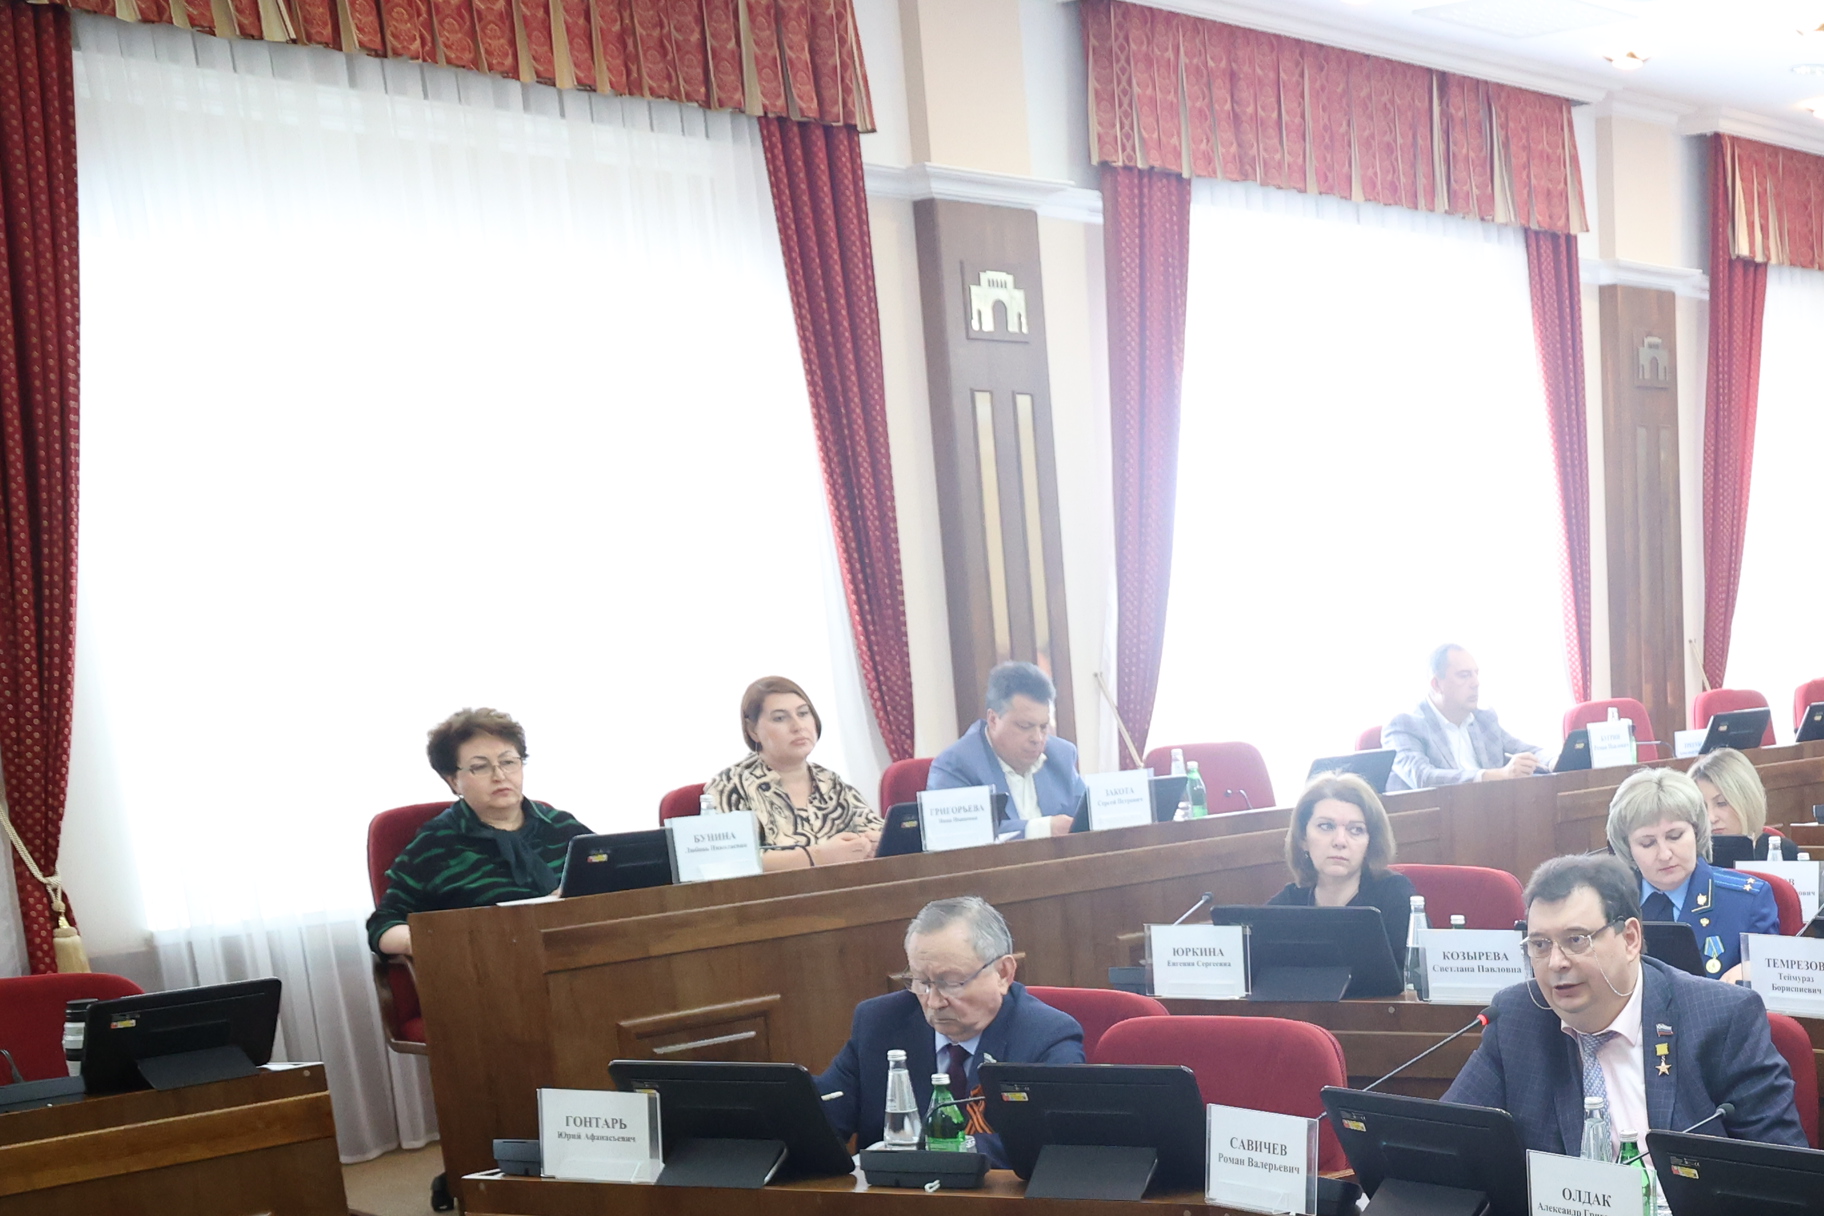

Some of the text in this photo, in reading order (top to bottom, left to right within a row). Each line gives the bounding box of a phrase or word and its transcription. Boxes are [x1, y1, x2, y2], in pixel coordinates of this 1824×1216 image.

[929, 804, 985, 816] ГРИГОРЬЕВА
[693, 832, 737, 843] БУНИНА
[1172, 947, 1225, 957] ЮРКИНА
[1442, 951, 1509, 961] КОЗЫРЕВА
[1432, 964, 1522, 974] Светлана Павловна
[1778, 972, 1815, 984] Теймураз
[565, 1115, 627, 1130] ГОНТАРЬ
[557, 1131, 636, 1143] Юрий Афанасьевич
[1229, 1136, 1288, 1156] САВИЧЕВ
[1218, 1152, 1300, 1175] Роман Валерьевич
[1562, 1187, 1612, 1208] ОЛДАК
